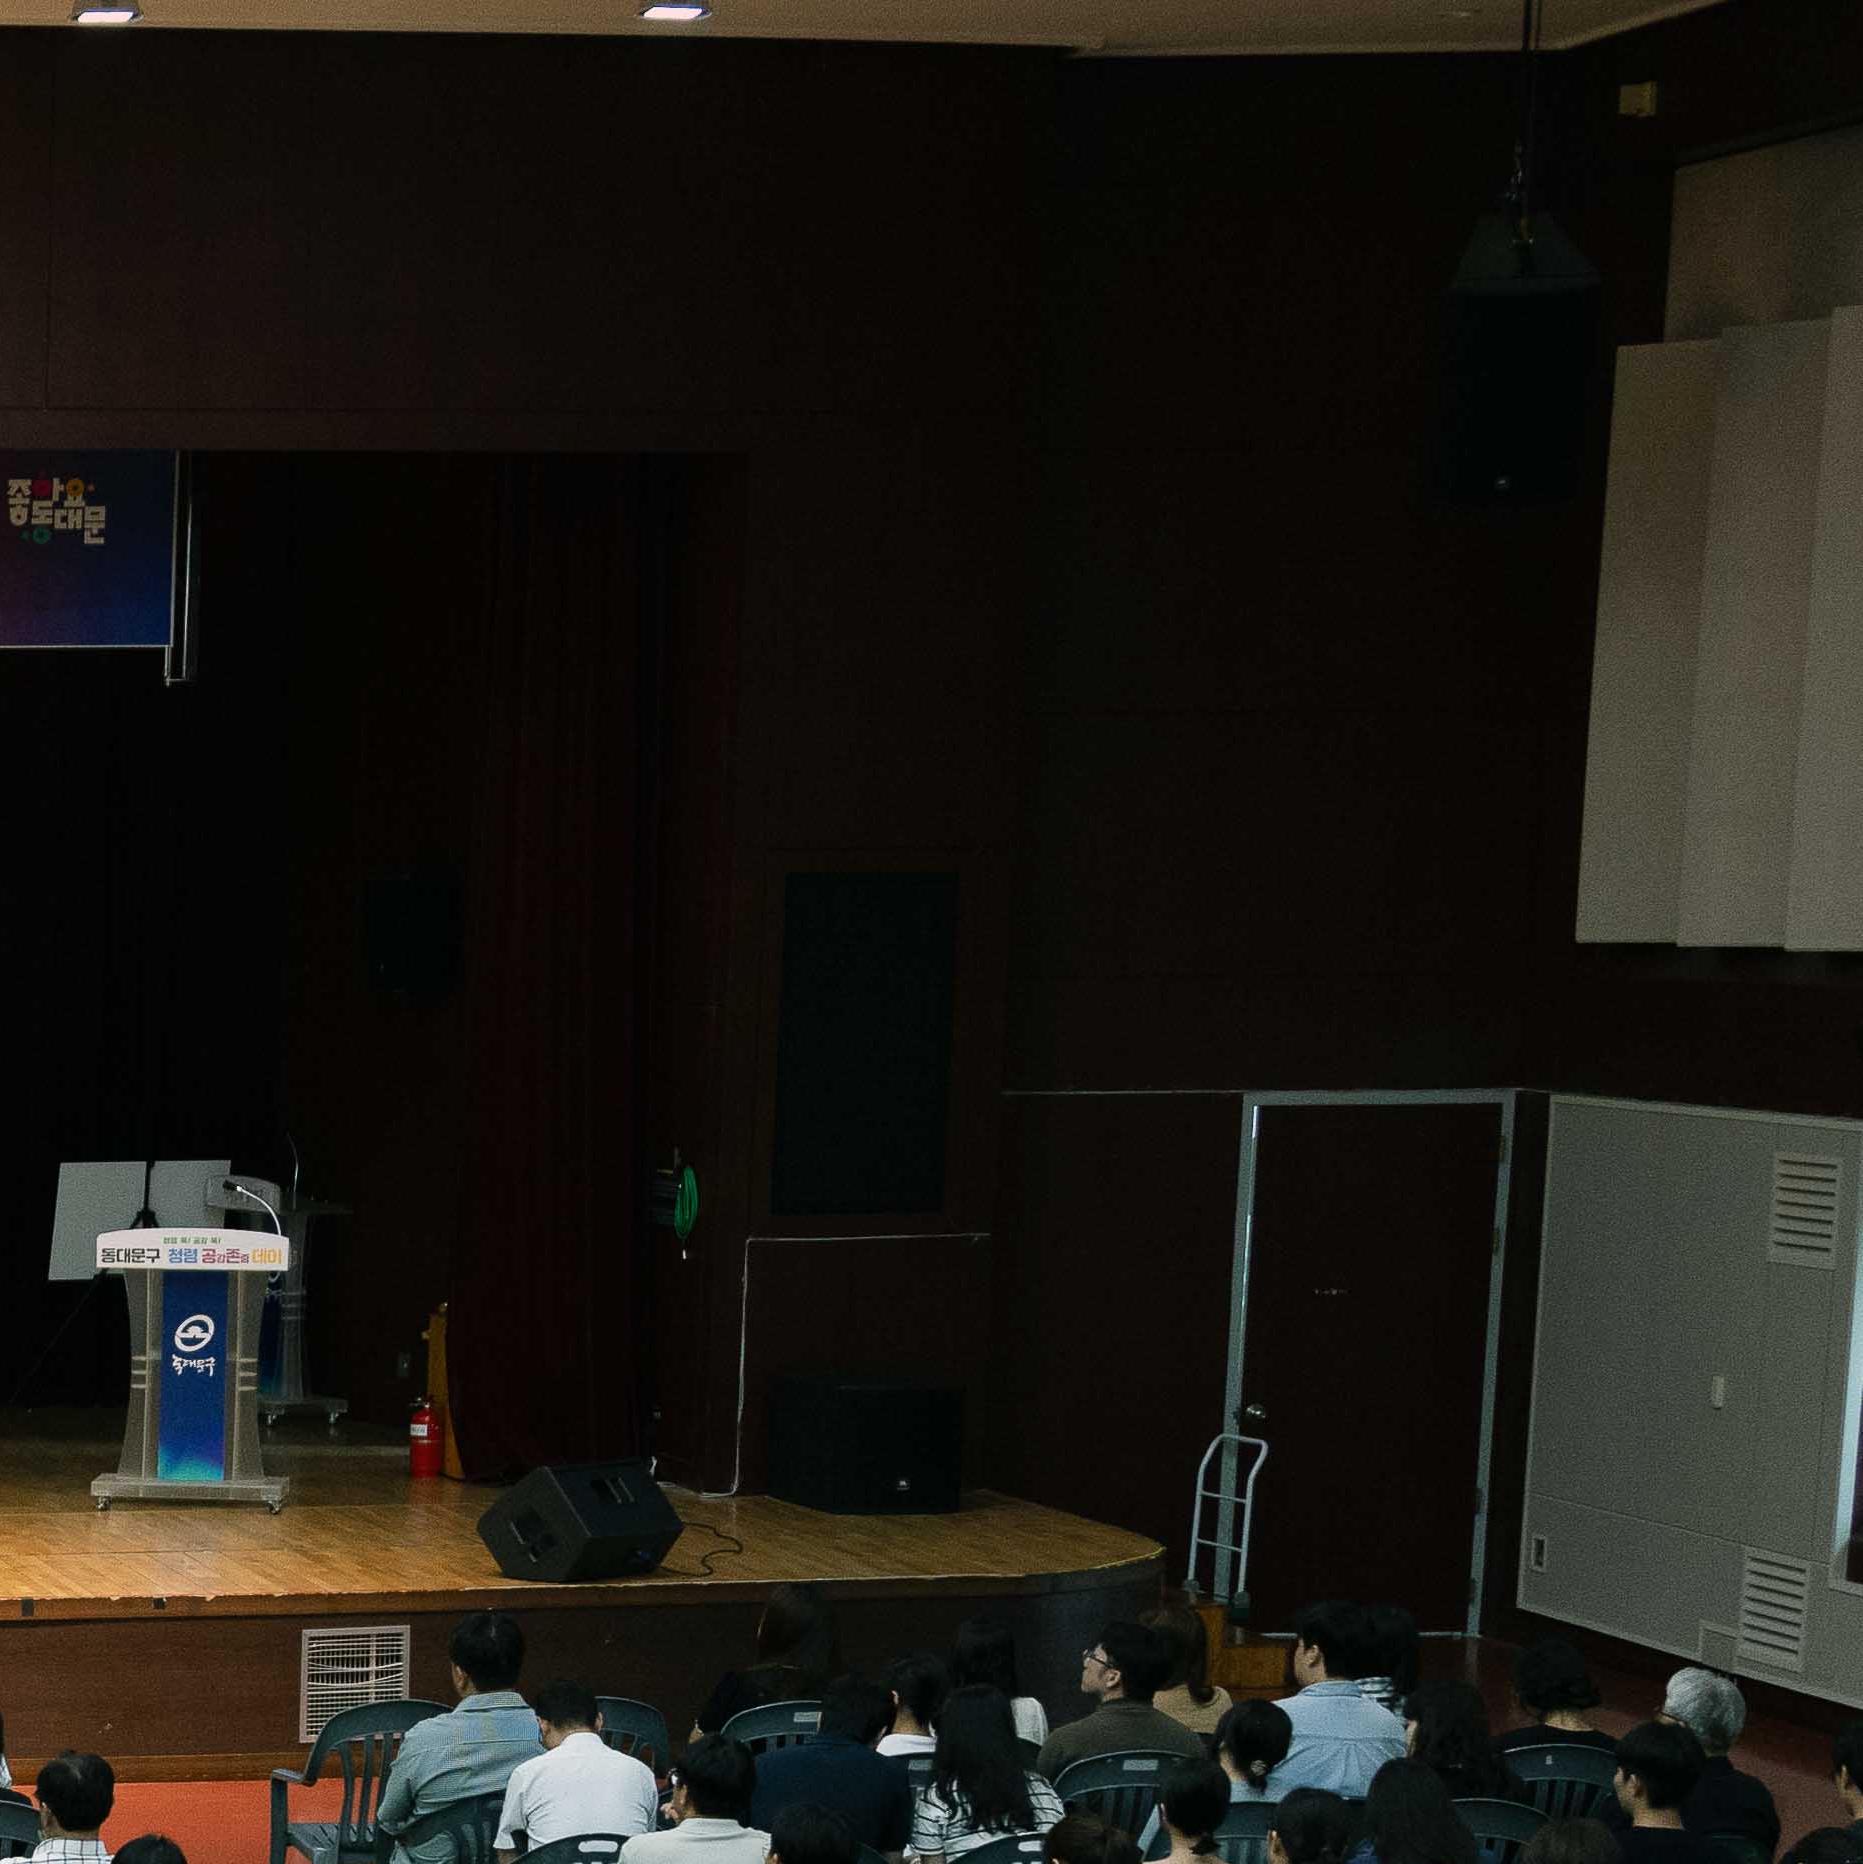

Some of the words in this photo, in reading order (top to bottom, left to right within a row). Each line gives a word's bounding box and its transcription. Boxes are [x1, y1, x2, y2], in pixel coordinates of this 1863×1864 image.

[101, 1247, 160, 1264] 동대문구
[169, 1247, 198, 1264] 청렴
[252, 1248, 282, 1264] 데이
